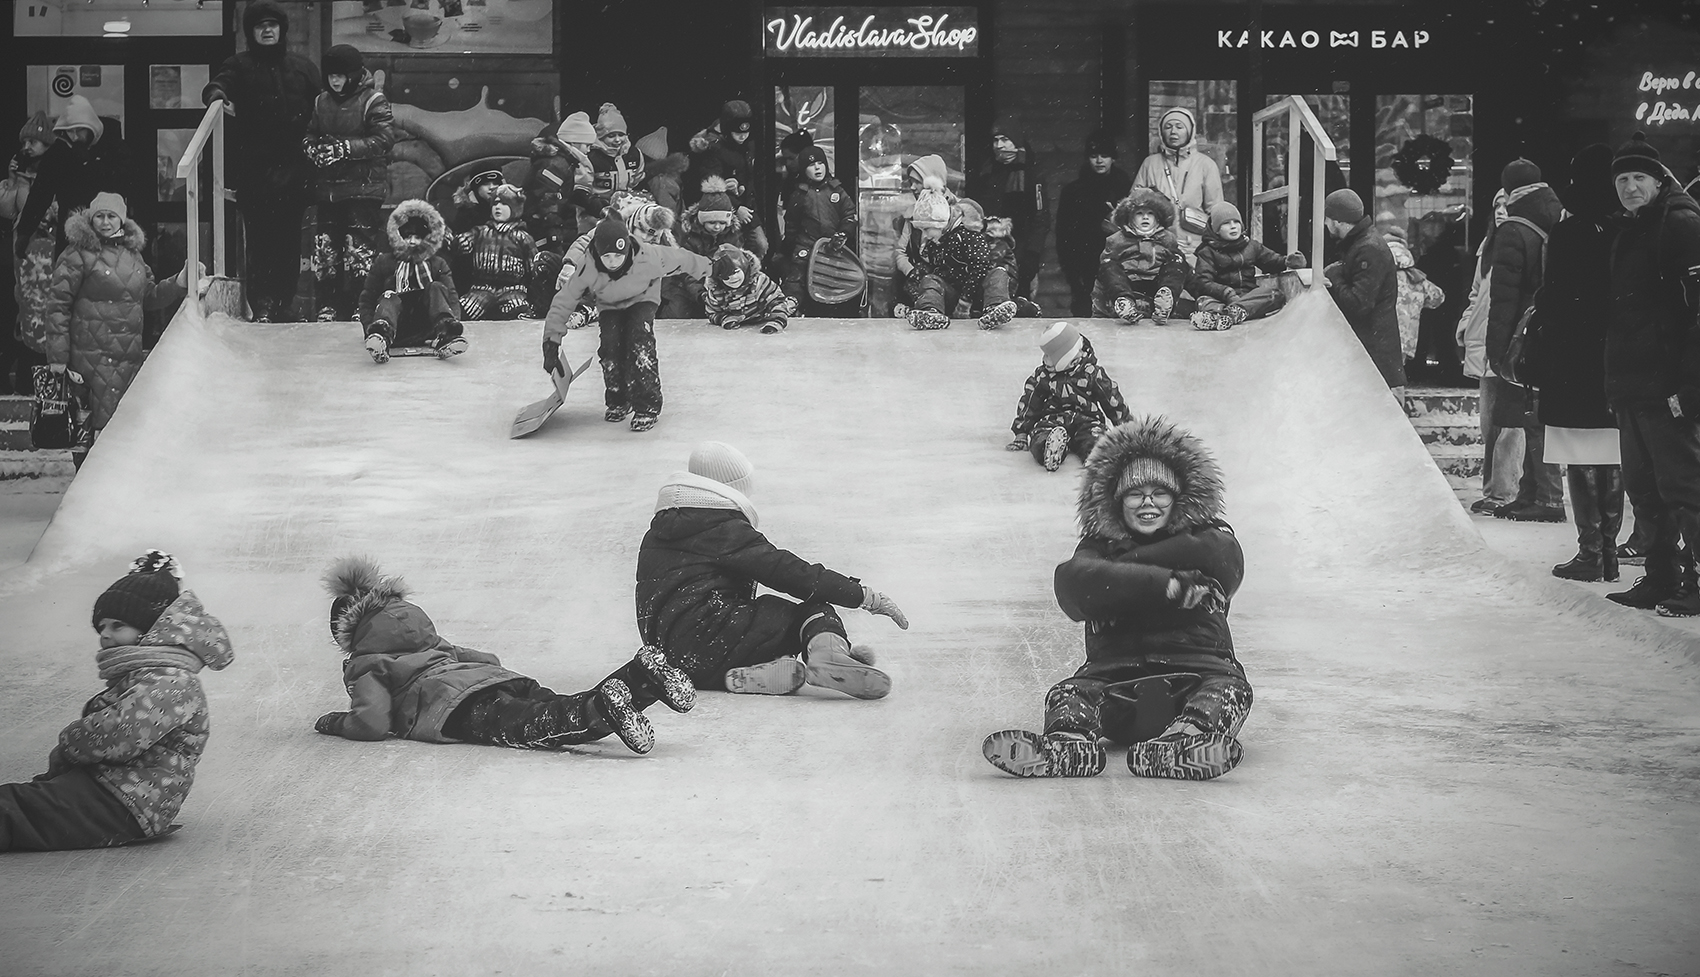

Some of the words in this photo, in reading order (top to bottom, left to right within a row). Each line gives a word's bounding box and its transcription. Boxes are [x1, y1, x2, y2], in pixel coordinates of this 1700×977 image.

[1371, 30, 1430, 48] БАР
[1638, 71, 1680, 96] Верю
[1682, 71, 1696, 89] в
[1635, 102, 1649, 120] в
[1646, 101, 1690, 125] Деда
